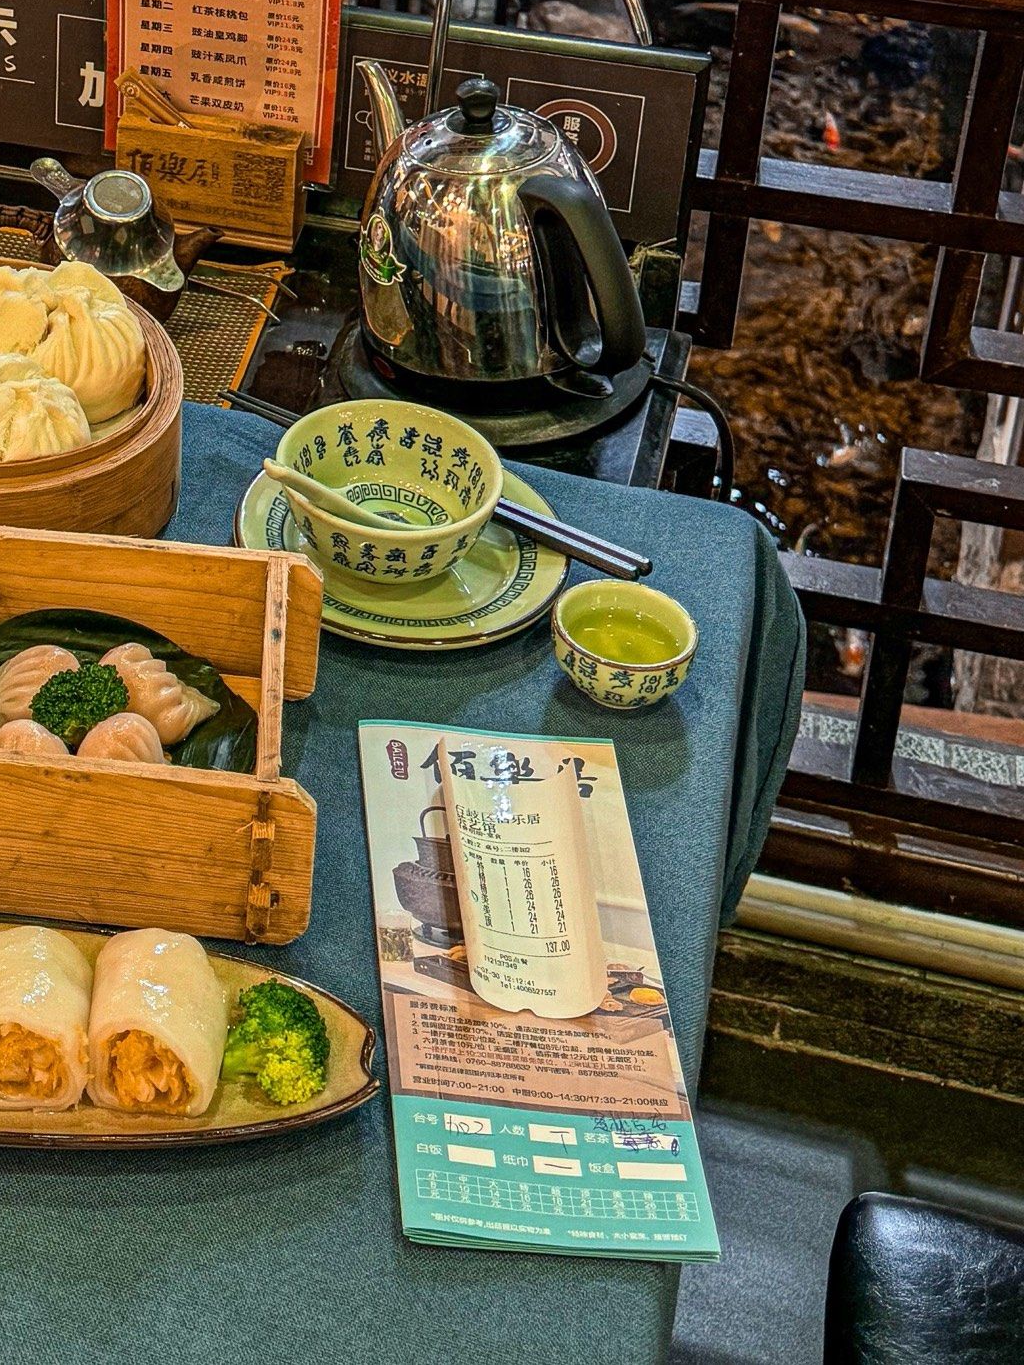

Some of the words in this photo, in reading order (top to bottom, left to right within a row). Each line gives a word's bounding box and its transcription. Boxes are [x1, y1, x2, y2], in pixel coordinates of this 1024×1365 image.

[192, 5, 248, 21] 红茶核桃包
[140, 20, 173, 33] 星期三
[191, 27, 248, 44] 豉油皇鸡脚
[140, 42, 173, 56] 星期四
[191, 50, 247, 66] 豉汁蒸凤爪
[139, 65, 173, 79] 星期五
[190, 71, 246, 89] 乳香咸煎饼
[189, 95, 244, 112] 芒果双皮奶
[541, 858, 555, 866] 小计
[522, 868, 530, 877] 16
[549, 866, 558, 875] 16
[523, 879, 532, 889] 26
[551, 877, 559, 887] 26
[525, 890, 534, 900] 26
[552, 888, 561, 898] 26
[526, 901, 536, 911] 24
[554, 900, 563, 910] 24
[528, 912, 537, 922] 24
[556, 911, 565, 921] 24
[530, 923, 539, 934] 21
[557, 922, 567, 933] 21
[545, 940, 571, 953] 137.00
[503, 975, 535, 987] 12:12:41
[410, 1001, 458, 1012] 服务费标准
[413, 1076, 505, 1094] 营业时间7:00-21:00
[413, 1113, 439, 1126] 台号
[499, 1123, 525, 1136] 人数
[584, 1132, 610, 1144] 茗茶
[416, 1143, 442, 1156] 白饭
[502, 1154, 529, 1167] 纸巾
[589, 1163, 615, 1175] 饭盒
